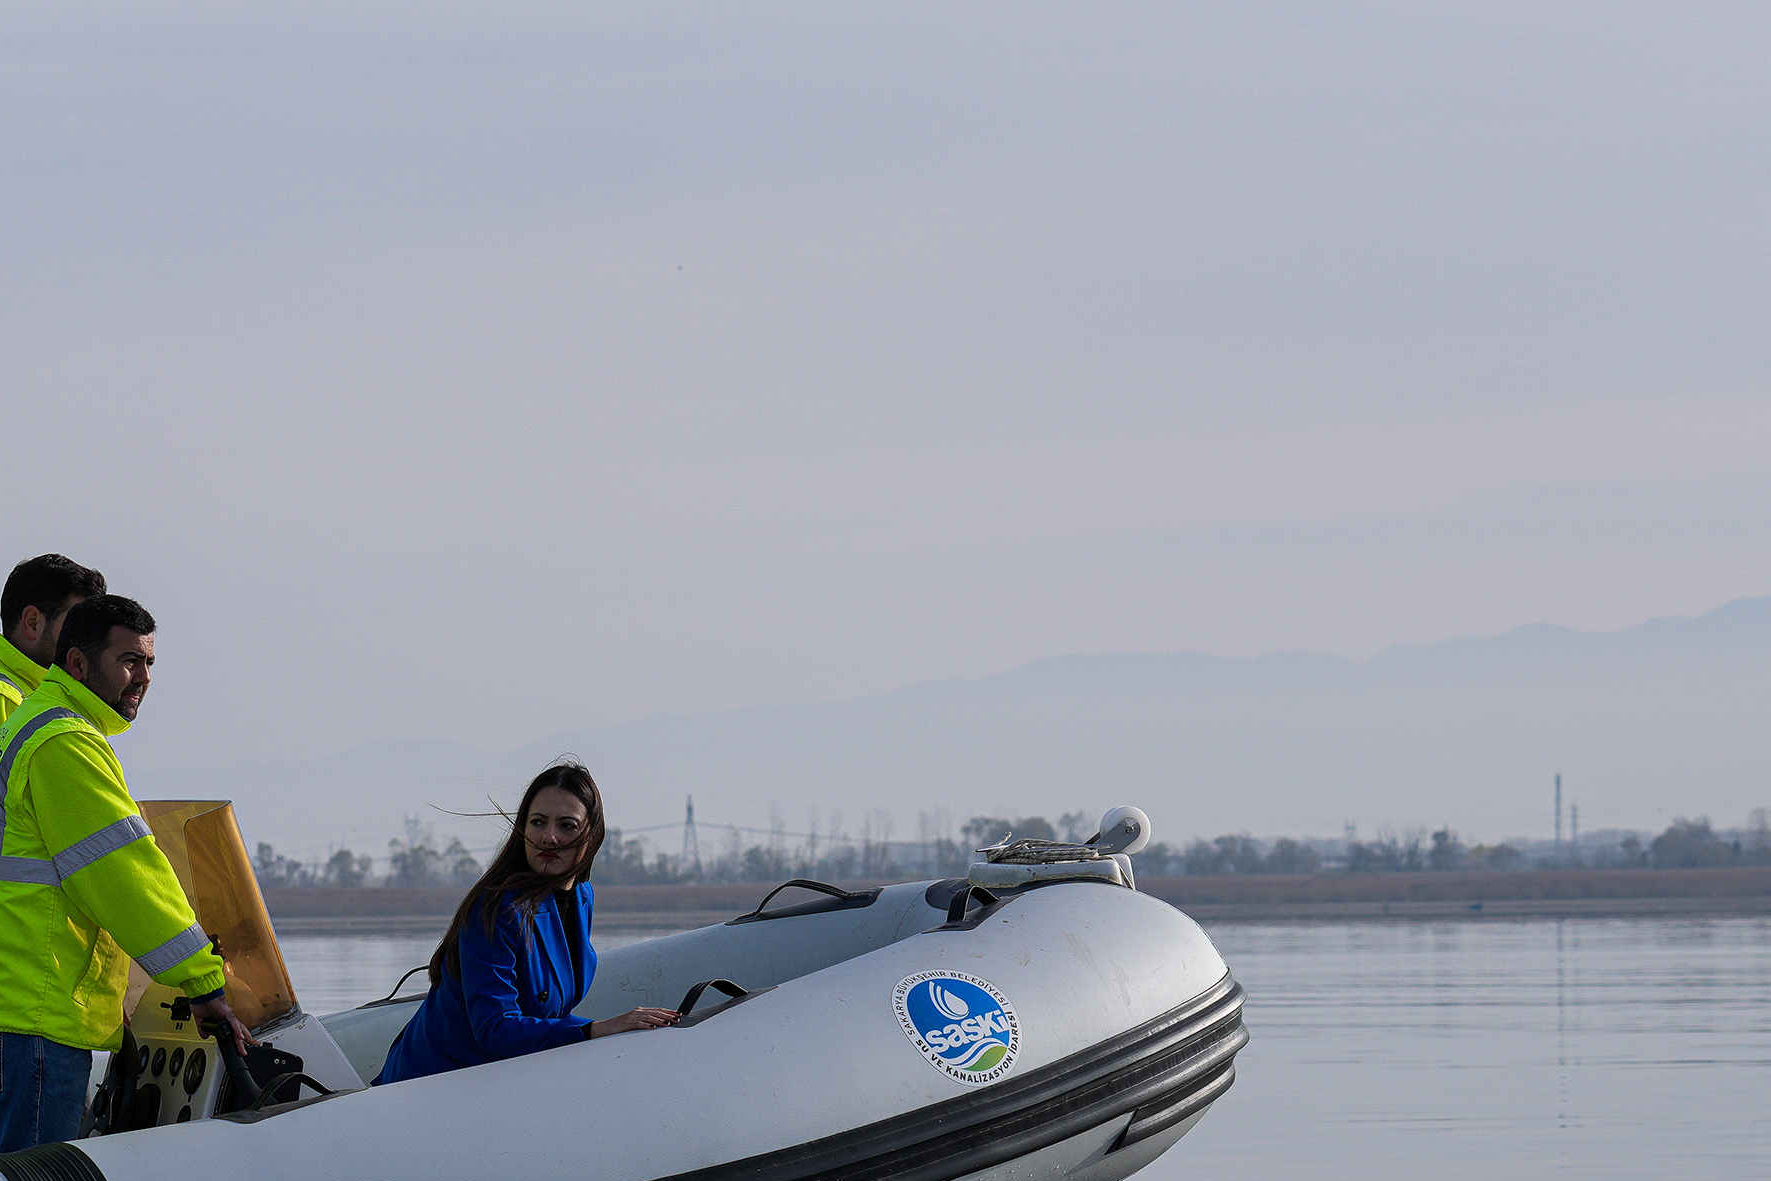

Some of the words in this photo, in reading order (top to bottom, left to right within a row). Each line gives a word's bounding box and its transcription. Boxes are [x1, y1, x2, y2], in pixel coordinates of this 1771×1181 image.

[896, 970, 947, 995] BÜYÜKŞEHİR
[949, 971, 1010, 1006] BELEDİYESİ
[895, 995, 916, 1036] SAKARYA
[915, 1039, 930, 1054] SU
[930, 1053, 944, 1068] VE
[945, 1055, 1014, 1083] KANALİZASYON
